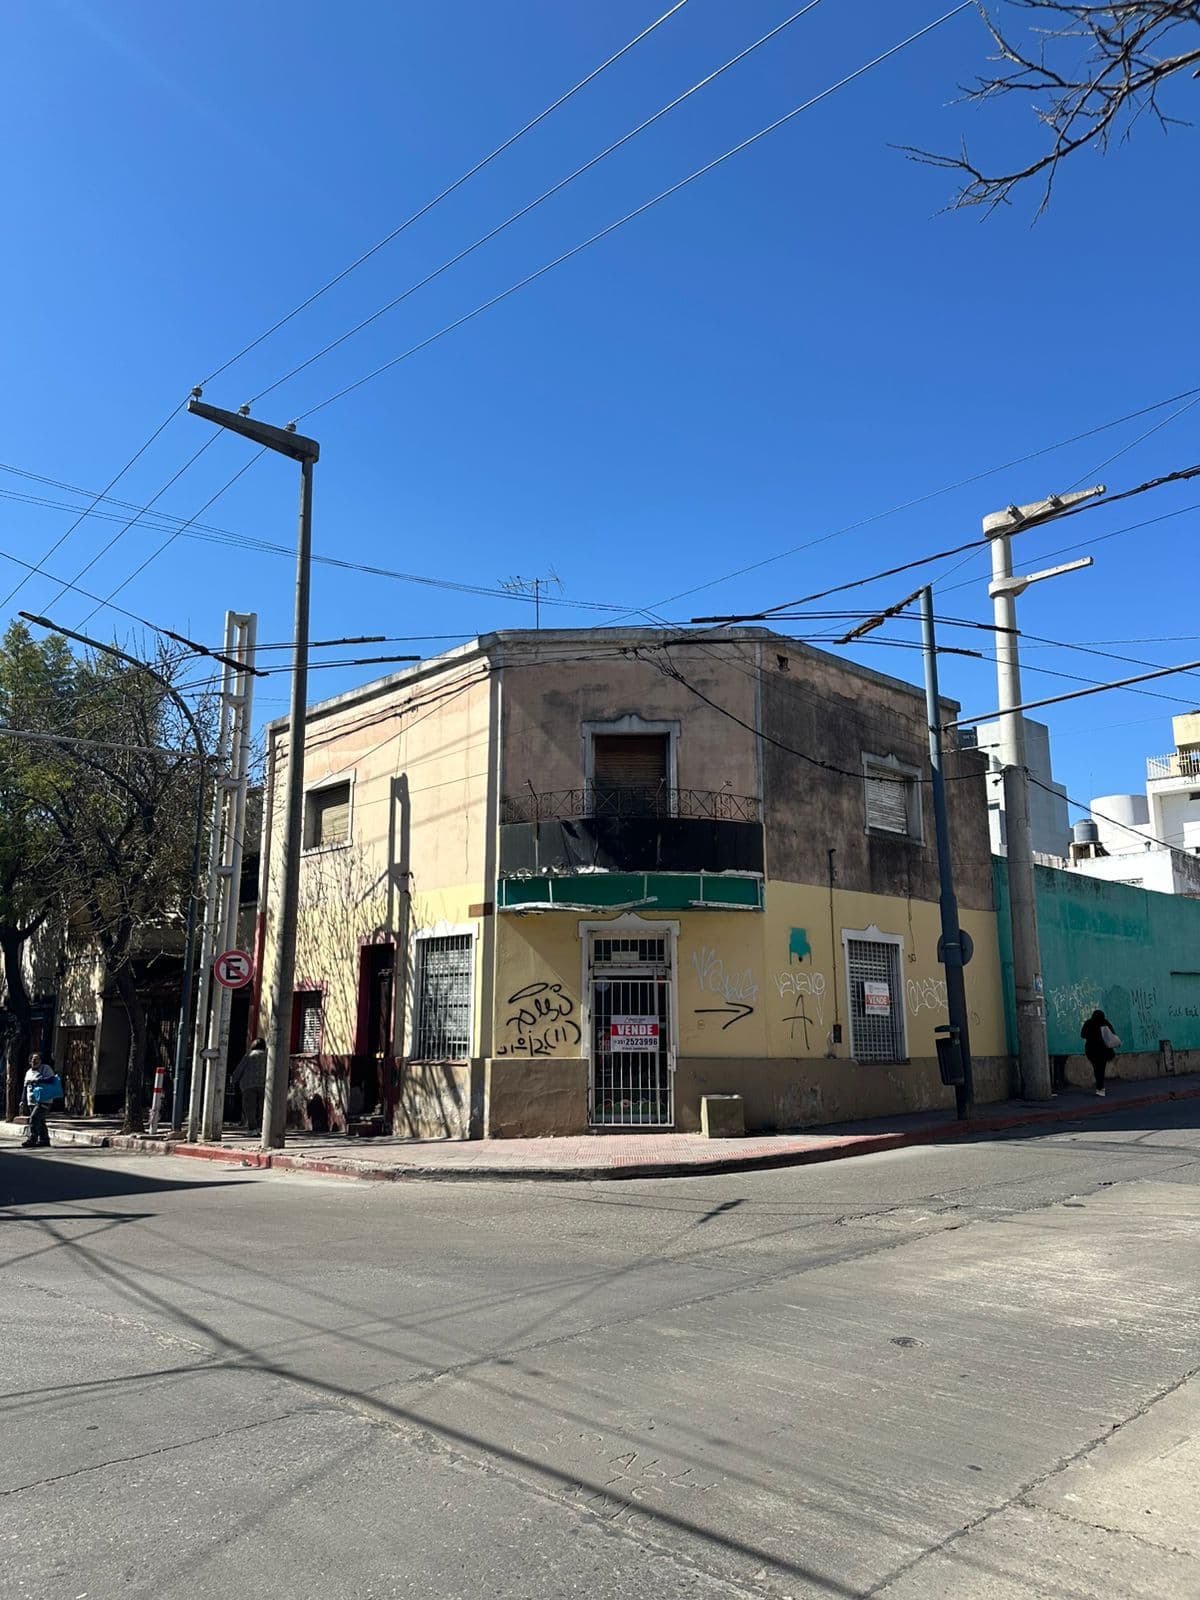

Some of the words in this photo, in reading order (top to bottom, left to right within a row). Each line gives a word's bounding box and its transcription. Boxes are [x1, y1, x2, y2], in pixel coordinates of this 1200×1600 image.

[226, 958, 242, 980] E
[867, 995, 887, 1005] VENDE
[616, 1025, 654, 1035] VENDE
